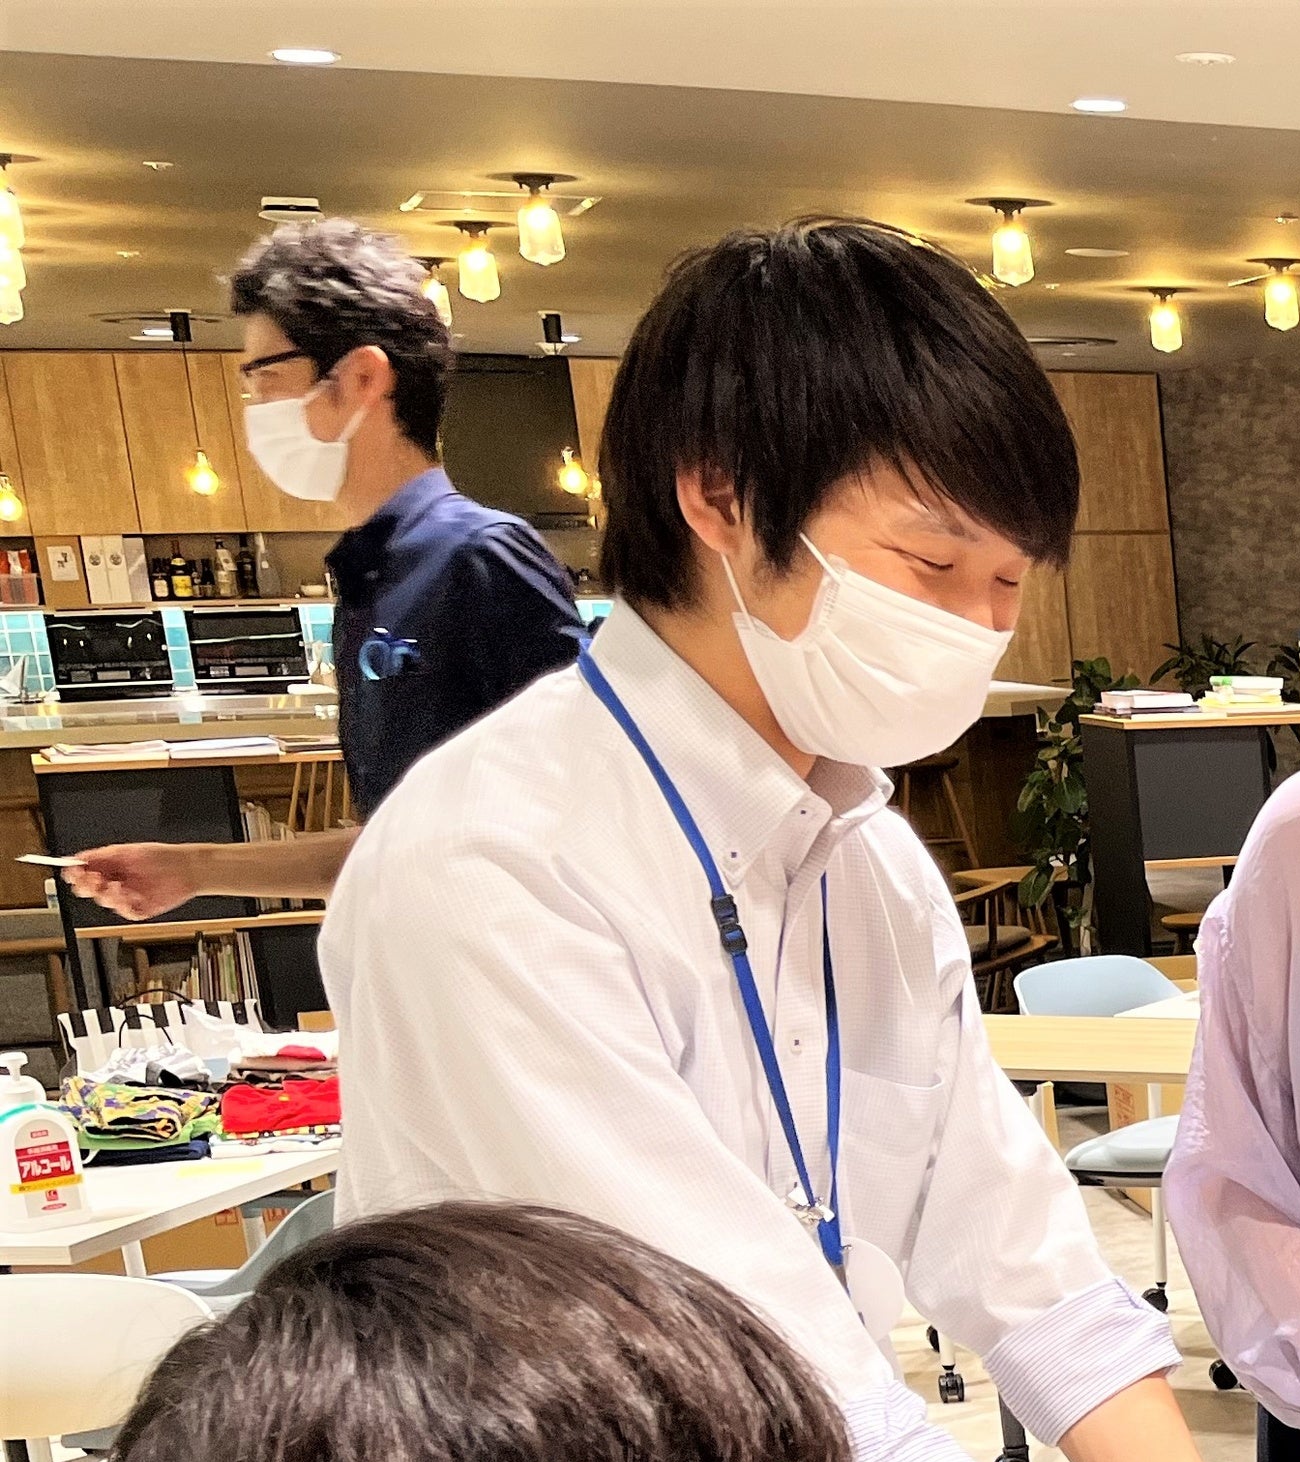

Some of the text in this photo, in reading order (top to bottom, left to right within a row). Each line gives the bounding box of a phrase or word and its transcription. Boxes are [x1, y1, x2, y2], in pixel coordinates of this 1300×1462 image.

[19, 1156, 71, 1179] アルコール
